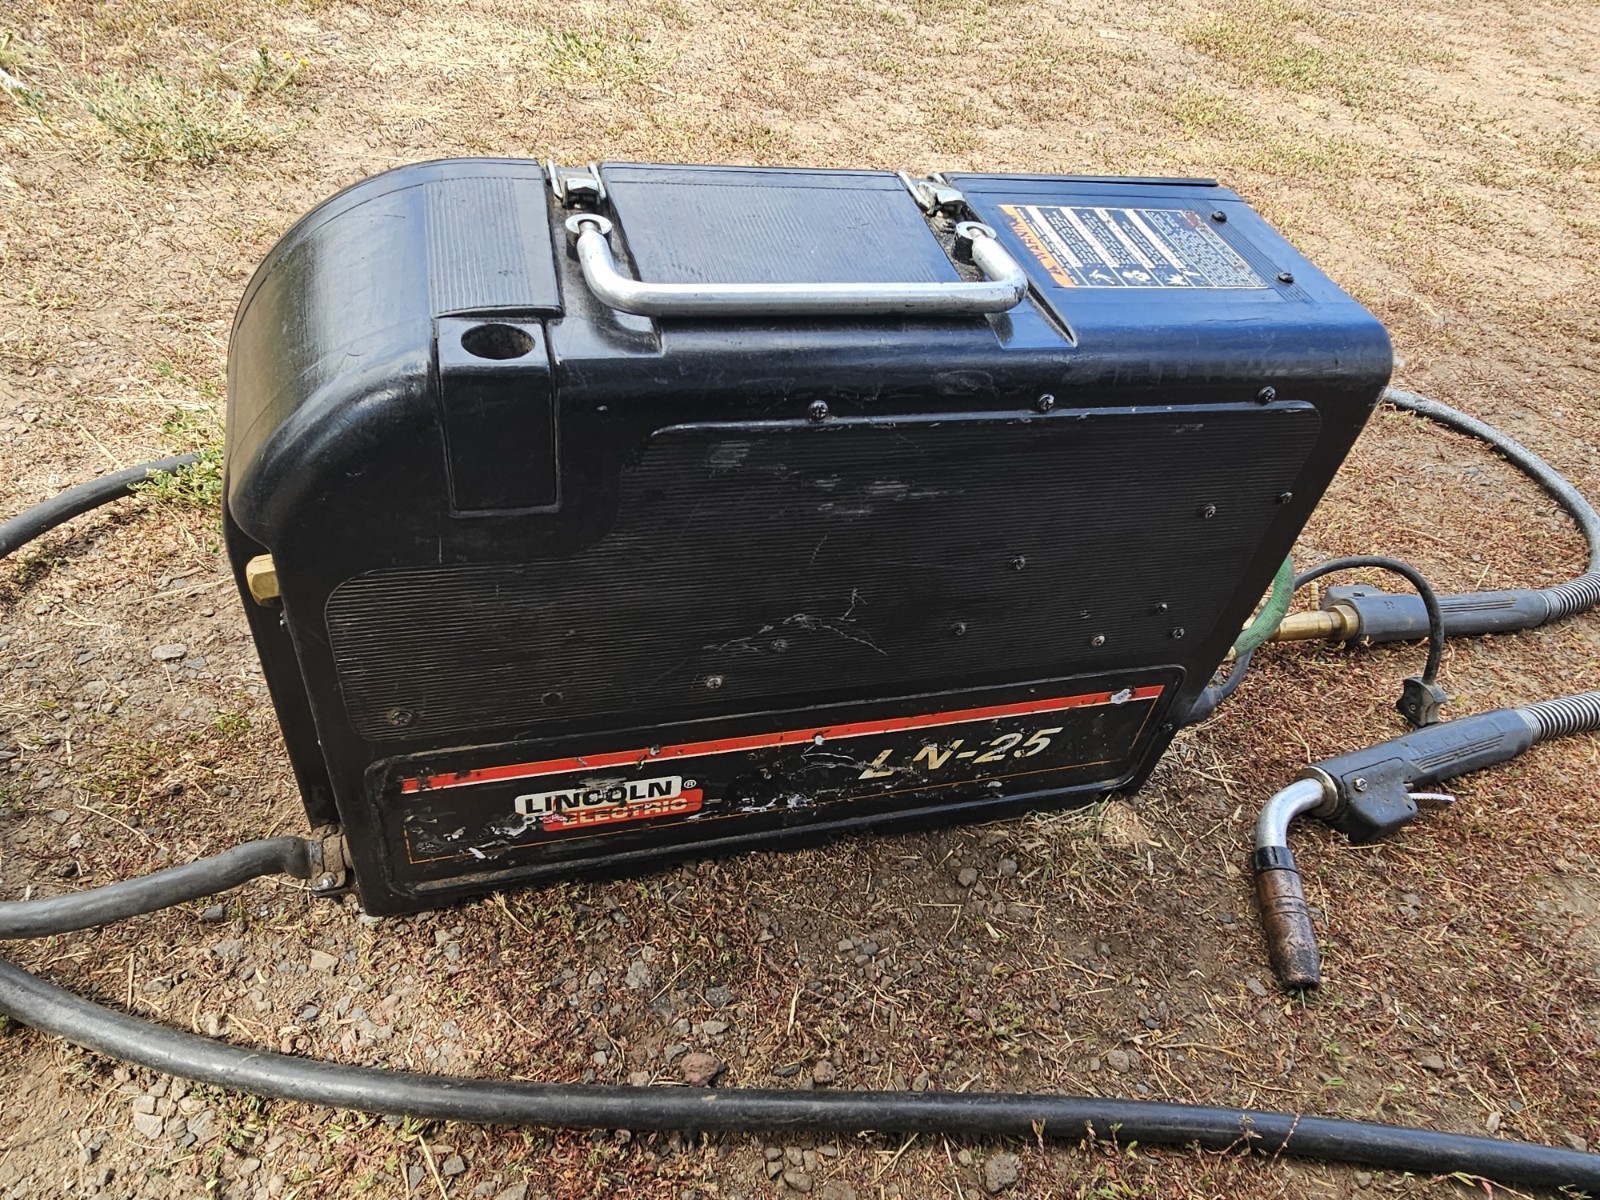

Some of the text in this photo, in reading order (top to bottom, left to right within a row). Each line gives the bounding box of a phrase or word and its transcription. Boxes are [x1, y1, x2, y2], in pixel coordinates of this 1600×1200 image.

[858, 727, 1064, 780] LN-25
[525, 780, 673, 814] LINCOLN
[562, 797, 689, 826] ELECTRIC
